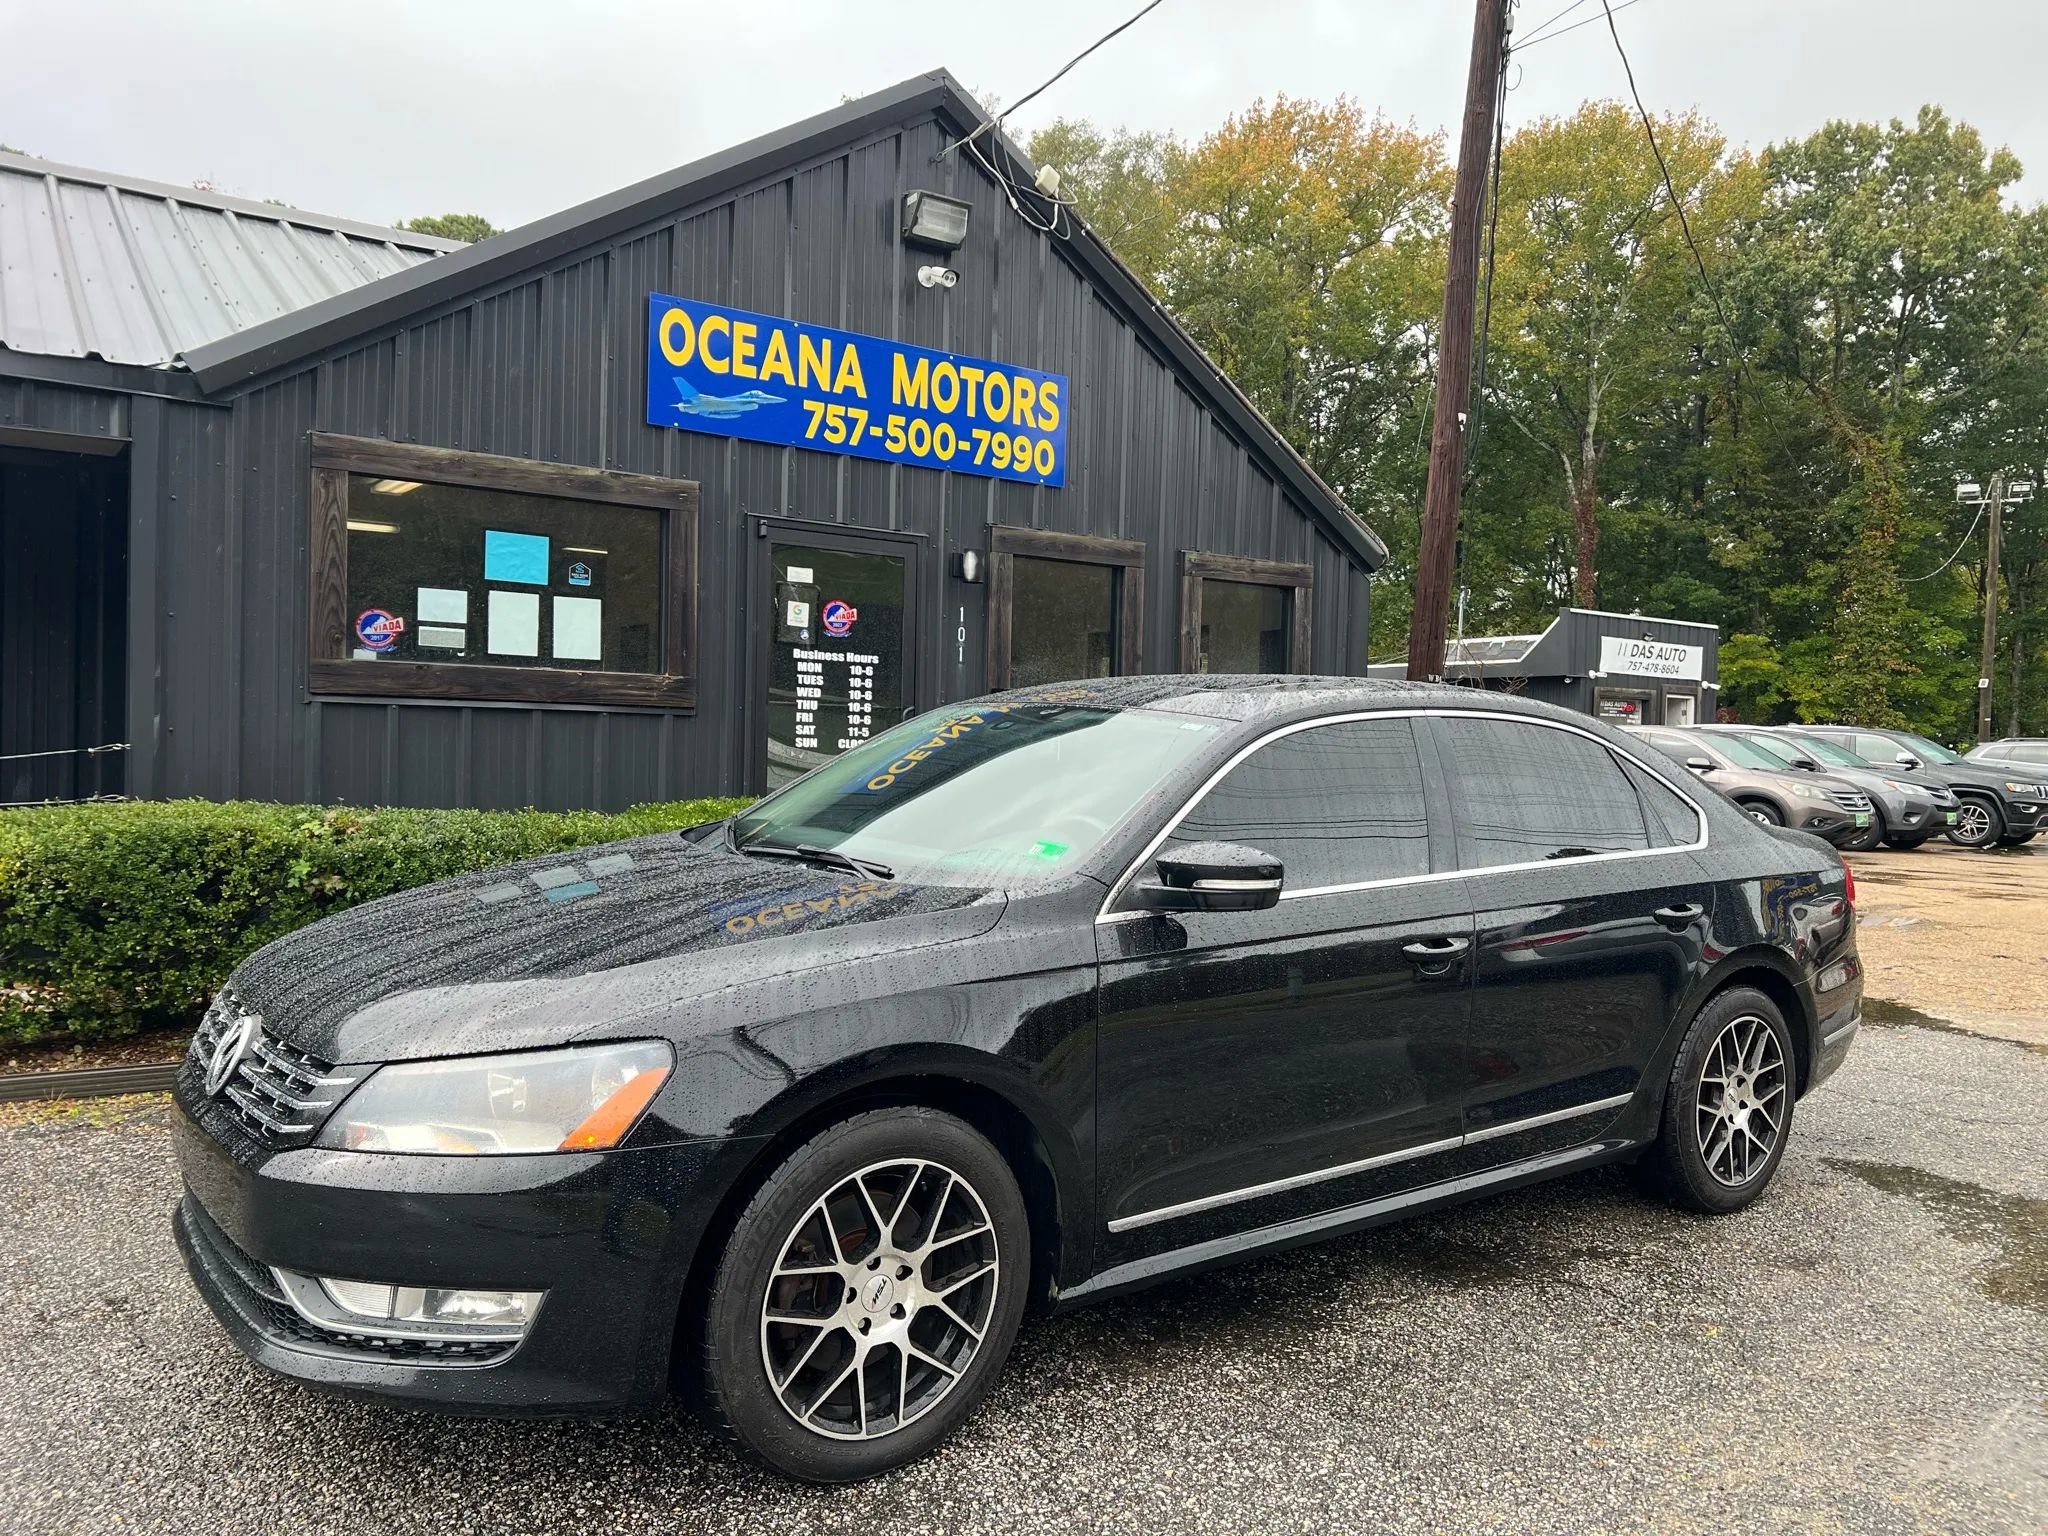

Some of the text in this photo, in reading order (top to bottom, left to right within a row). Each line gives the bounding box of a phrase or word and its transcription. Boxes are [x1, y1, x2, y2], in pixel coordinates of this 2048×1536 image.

[659, 307, 1060, 433] OCEANA MOTORS
[803, 399, 1055, 477] 757-500-7990
[373, 620, 402, 632] VIADA
[957, 606, 966, 662] 101
[793, 648, 879, 664] Business Hours
[1630, 644, 1655, 659] DAS
[1655, 647, 1687, 663] AUTO
[797, 661, 873, 676] MON 10-6
[1627, 660, 1680, 674] 757-478-8604
[796, 674, 873, 689] TUES 10-6
[796, 686, 873, 701] WED 10-6
[796, 699, 872, 713] THU 10-6
[796, 711, 872, 725] FRI 10-6
[795, 725, 870, 738] SAT 11-5
[795, 737, 818, 748] SUN
